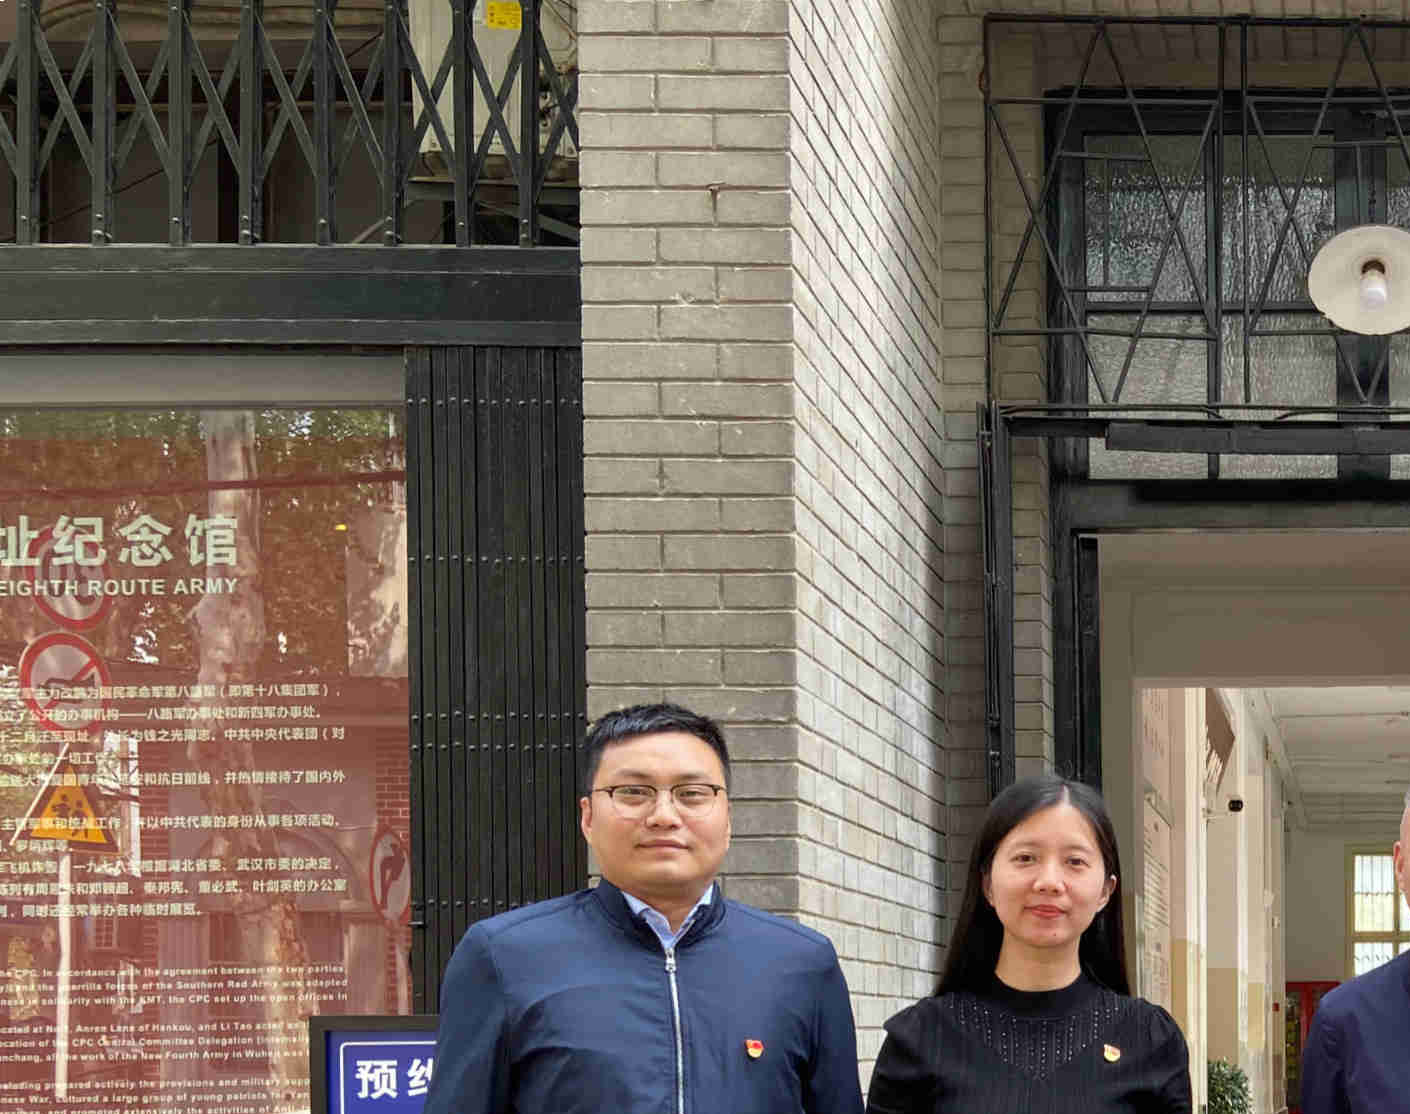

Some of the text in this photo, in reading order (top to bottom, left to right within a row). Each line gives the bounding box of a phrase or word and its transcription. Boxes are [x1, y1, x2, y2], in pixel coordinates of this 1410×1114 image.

[0, 514, 239, 567] 址纪念馆
[0, 576, 239, 597] EIGHTH ROUTE ARMY
[42, 996, 90, 1007] solarity
[202, 1049, 229, 1061] Army
